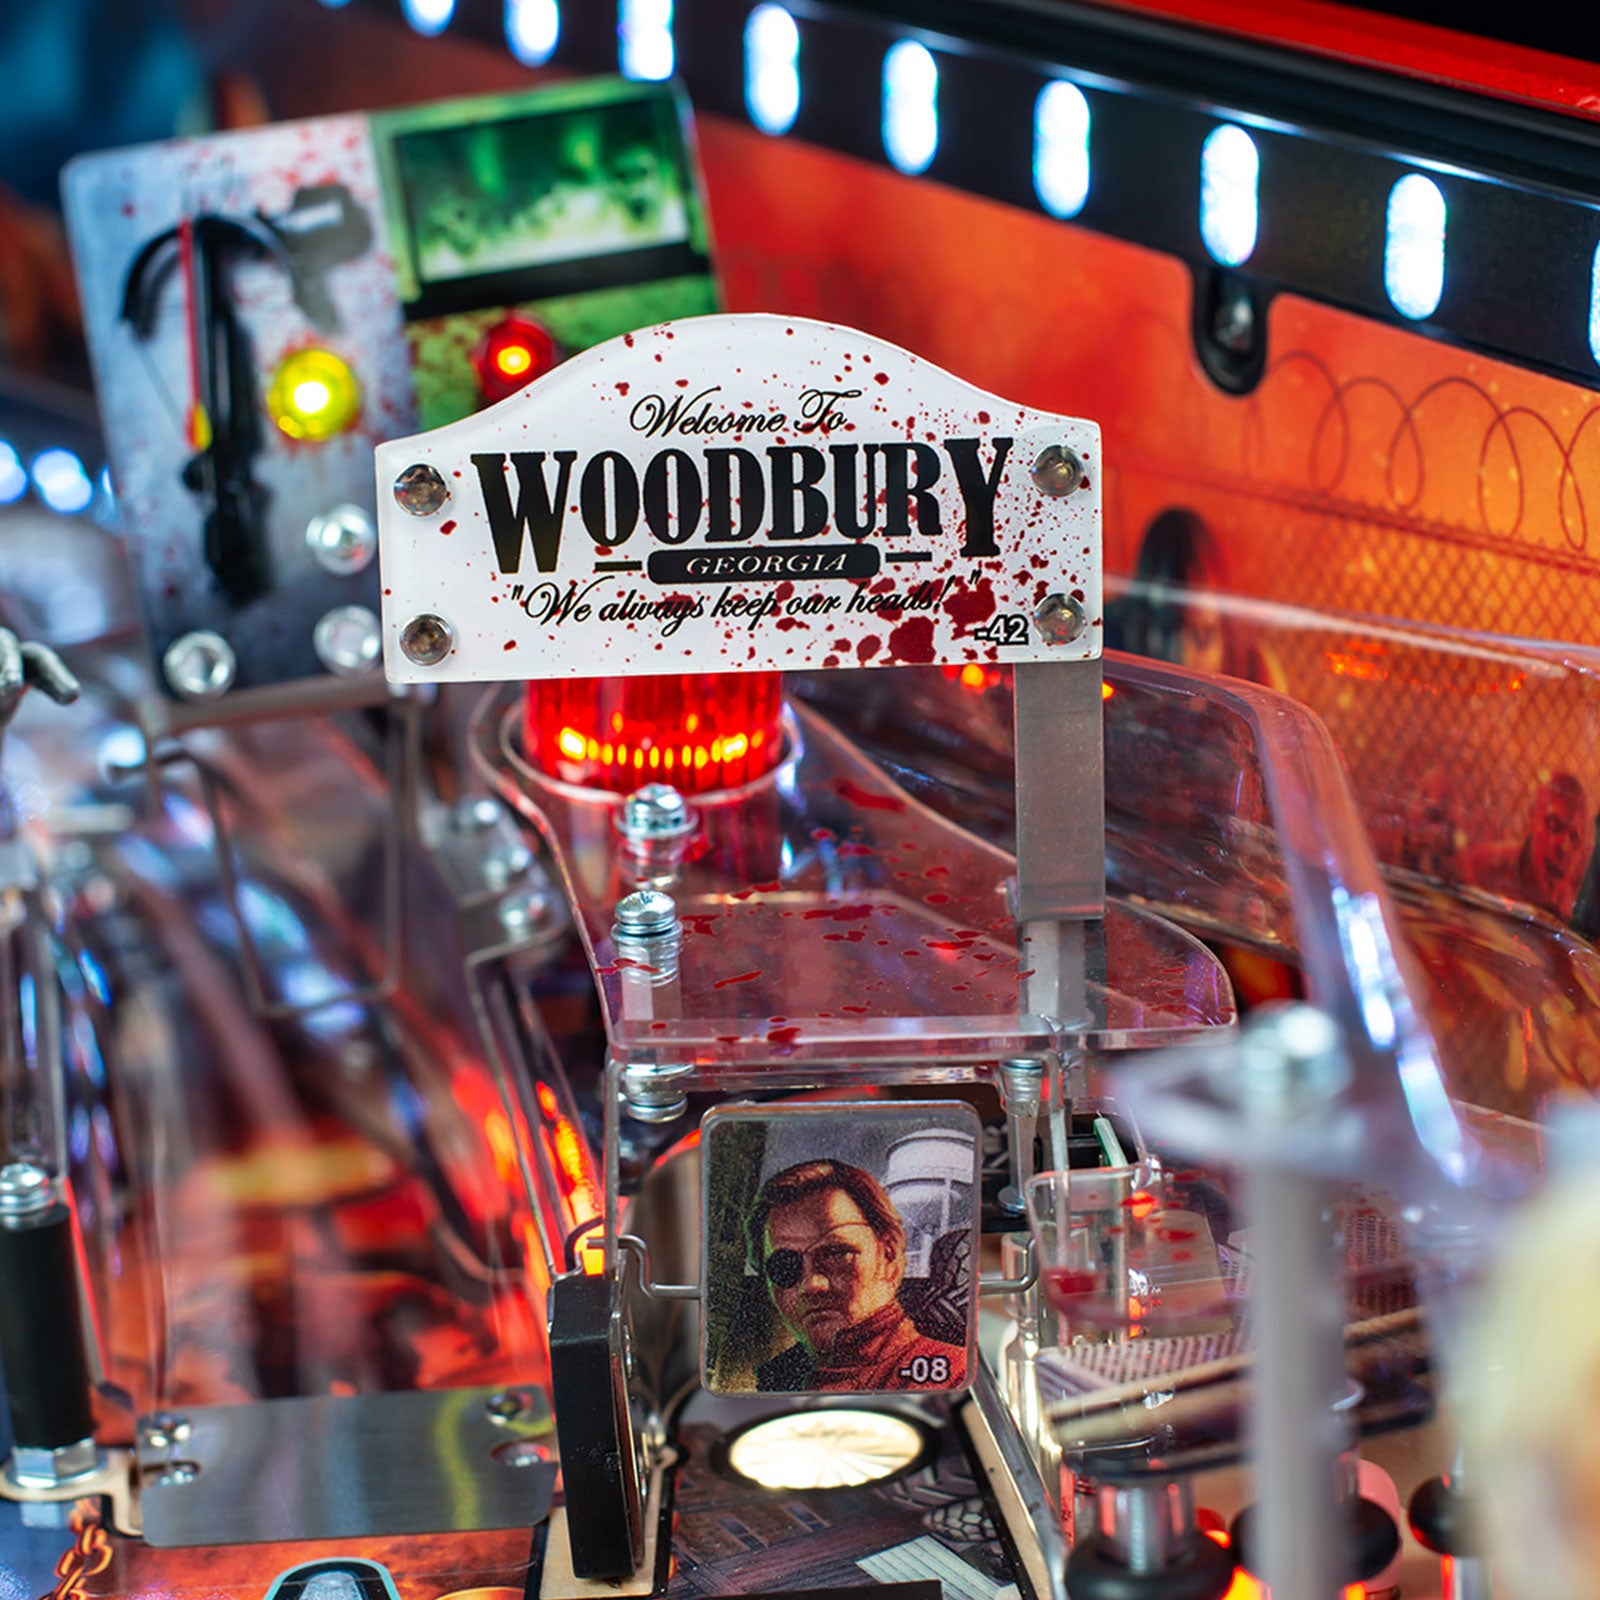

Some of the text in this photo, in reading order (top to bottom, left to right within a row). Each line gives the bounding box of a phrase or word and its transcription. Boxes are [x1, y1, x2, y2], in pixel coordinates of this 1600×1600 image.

[629, 386, 863, 438] Welcome To
[470, 436, 1014, 575] WOODBURY
[686, 552, 848, 575] GEORGIA
[598, 588, 705, 638] always
[710, 585, 777, 632] keep
[786, 597, 842, 616] our
[974, 614, 1030, 646] -42
[900, 1356, 950, 1384] -08
